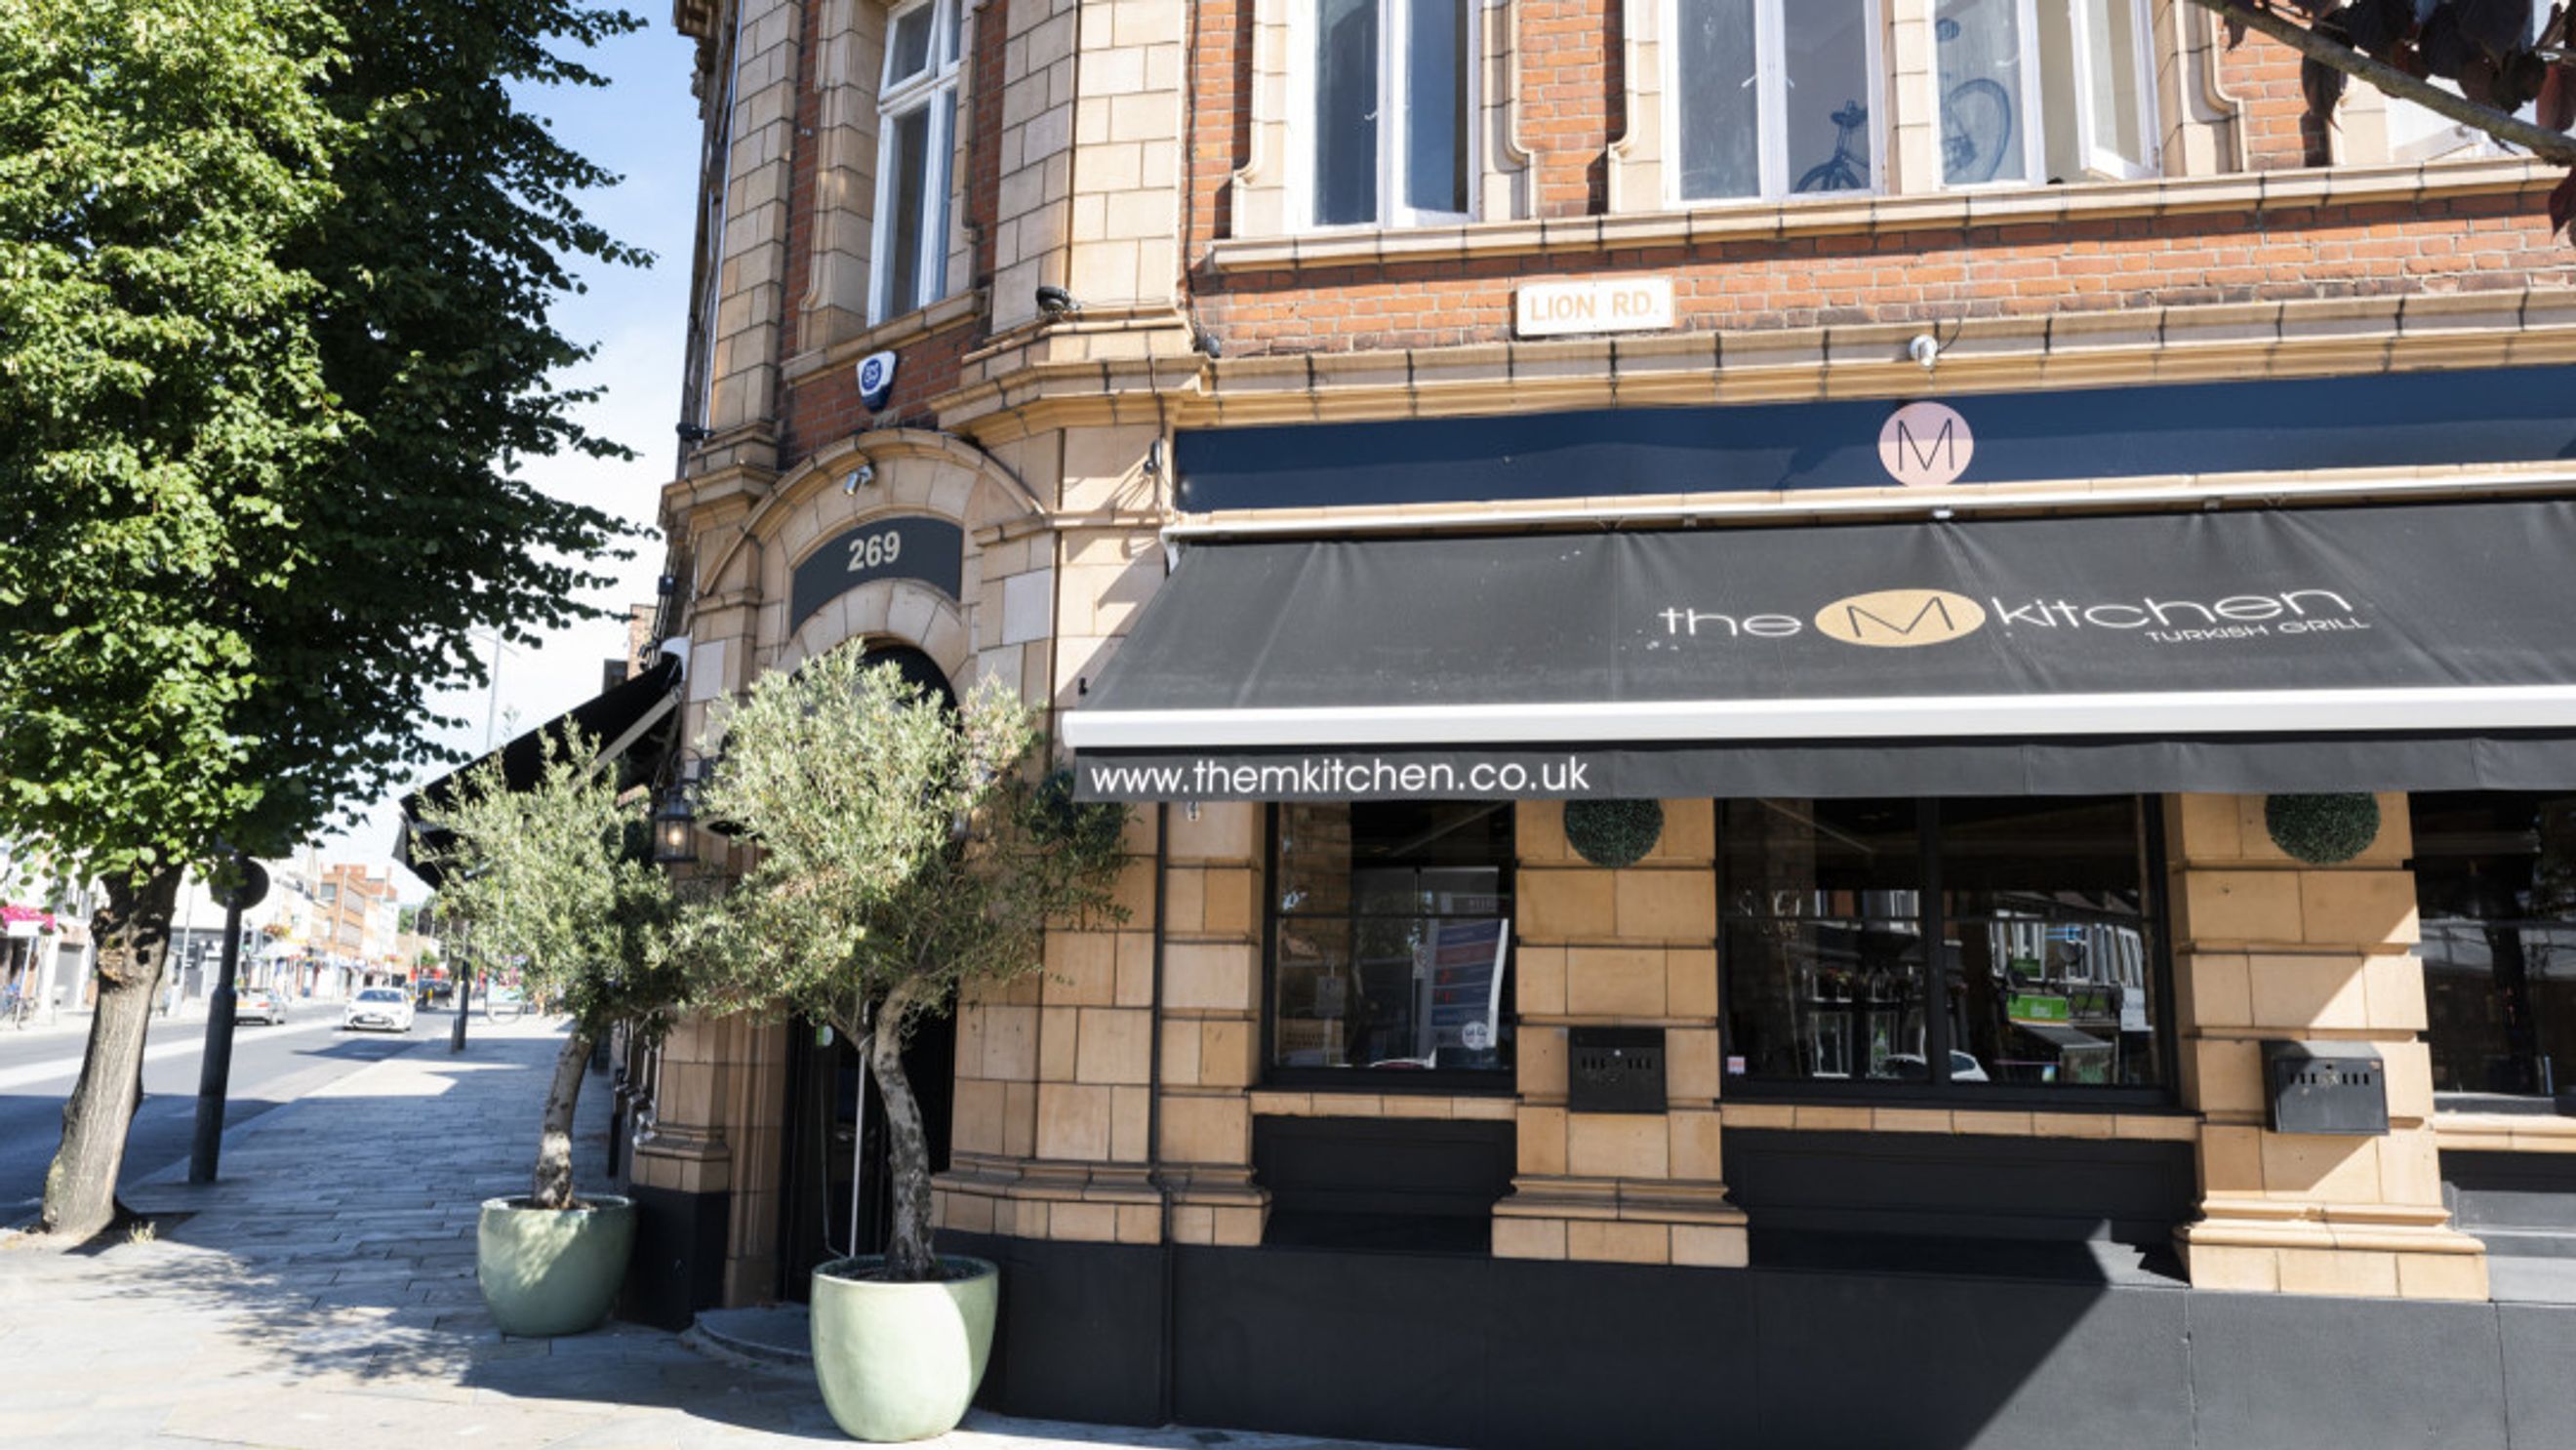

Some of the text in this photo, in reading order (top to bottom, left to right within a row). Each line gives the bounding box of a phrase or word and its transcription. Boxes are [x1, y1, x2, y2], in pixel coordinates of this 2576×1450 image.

[1530, 293, 1595, 321] LION
[1898, 418, 1954, 471] M
[847, 531, 901, 572] 269
[1658, 588, 2353, 638] the M kitchen
[2145, 617, 2372, 643] TURKISH GRILL
[1090, 756, 1590, 793] www.themkitchen.co.uk
